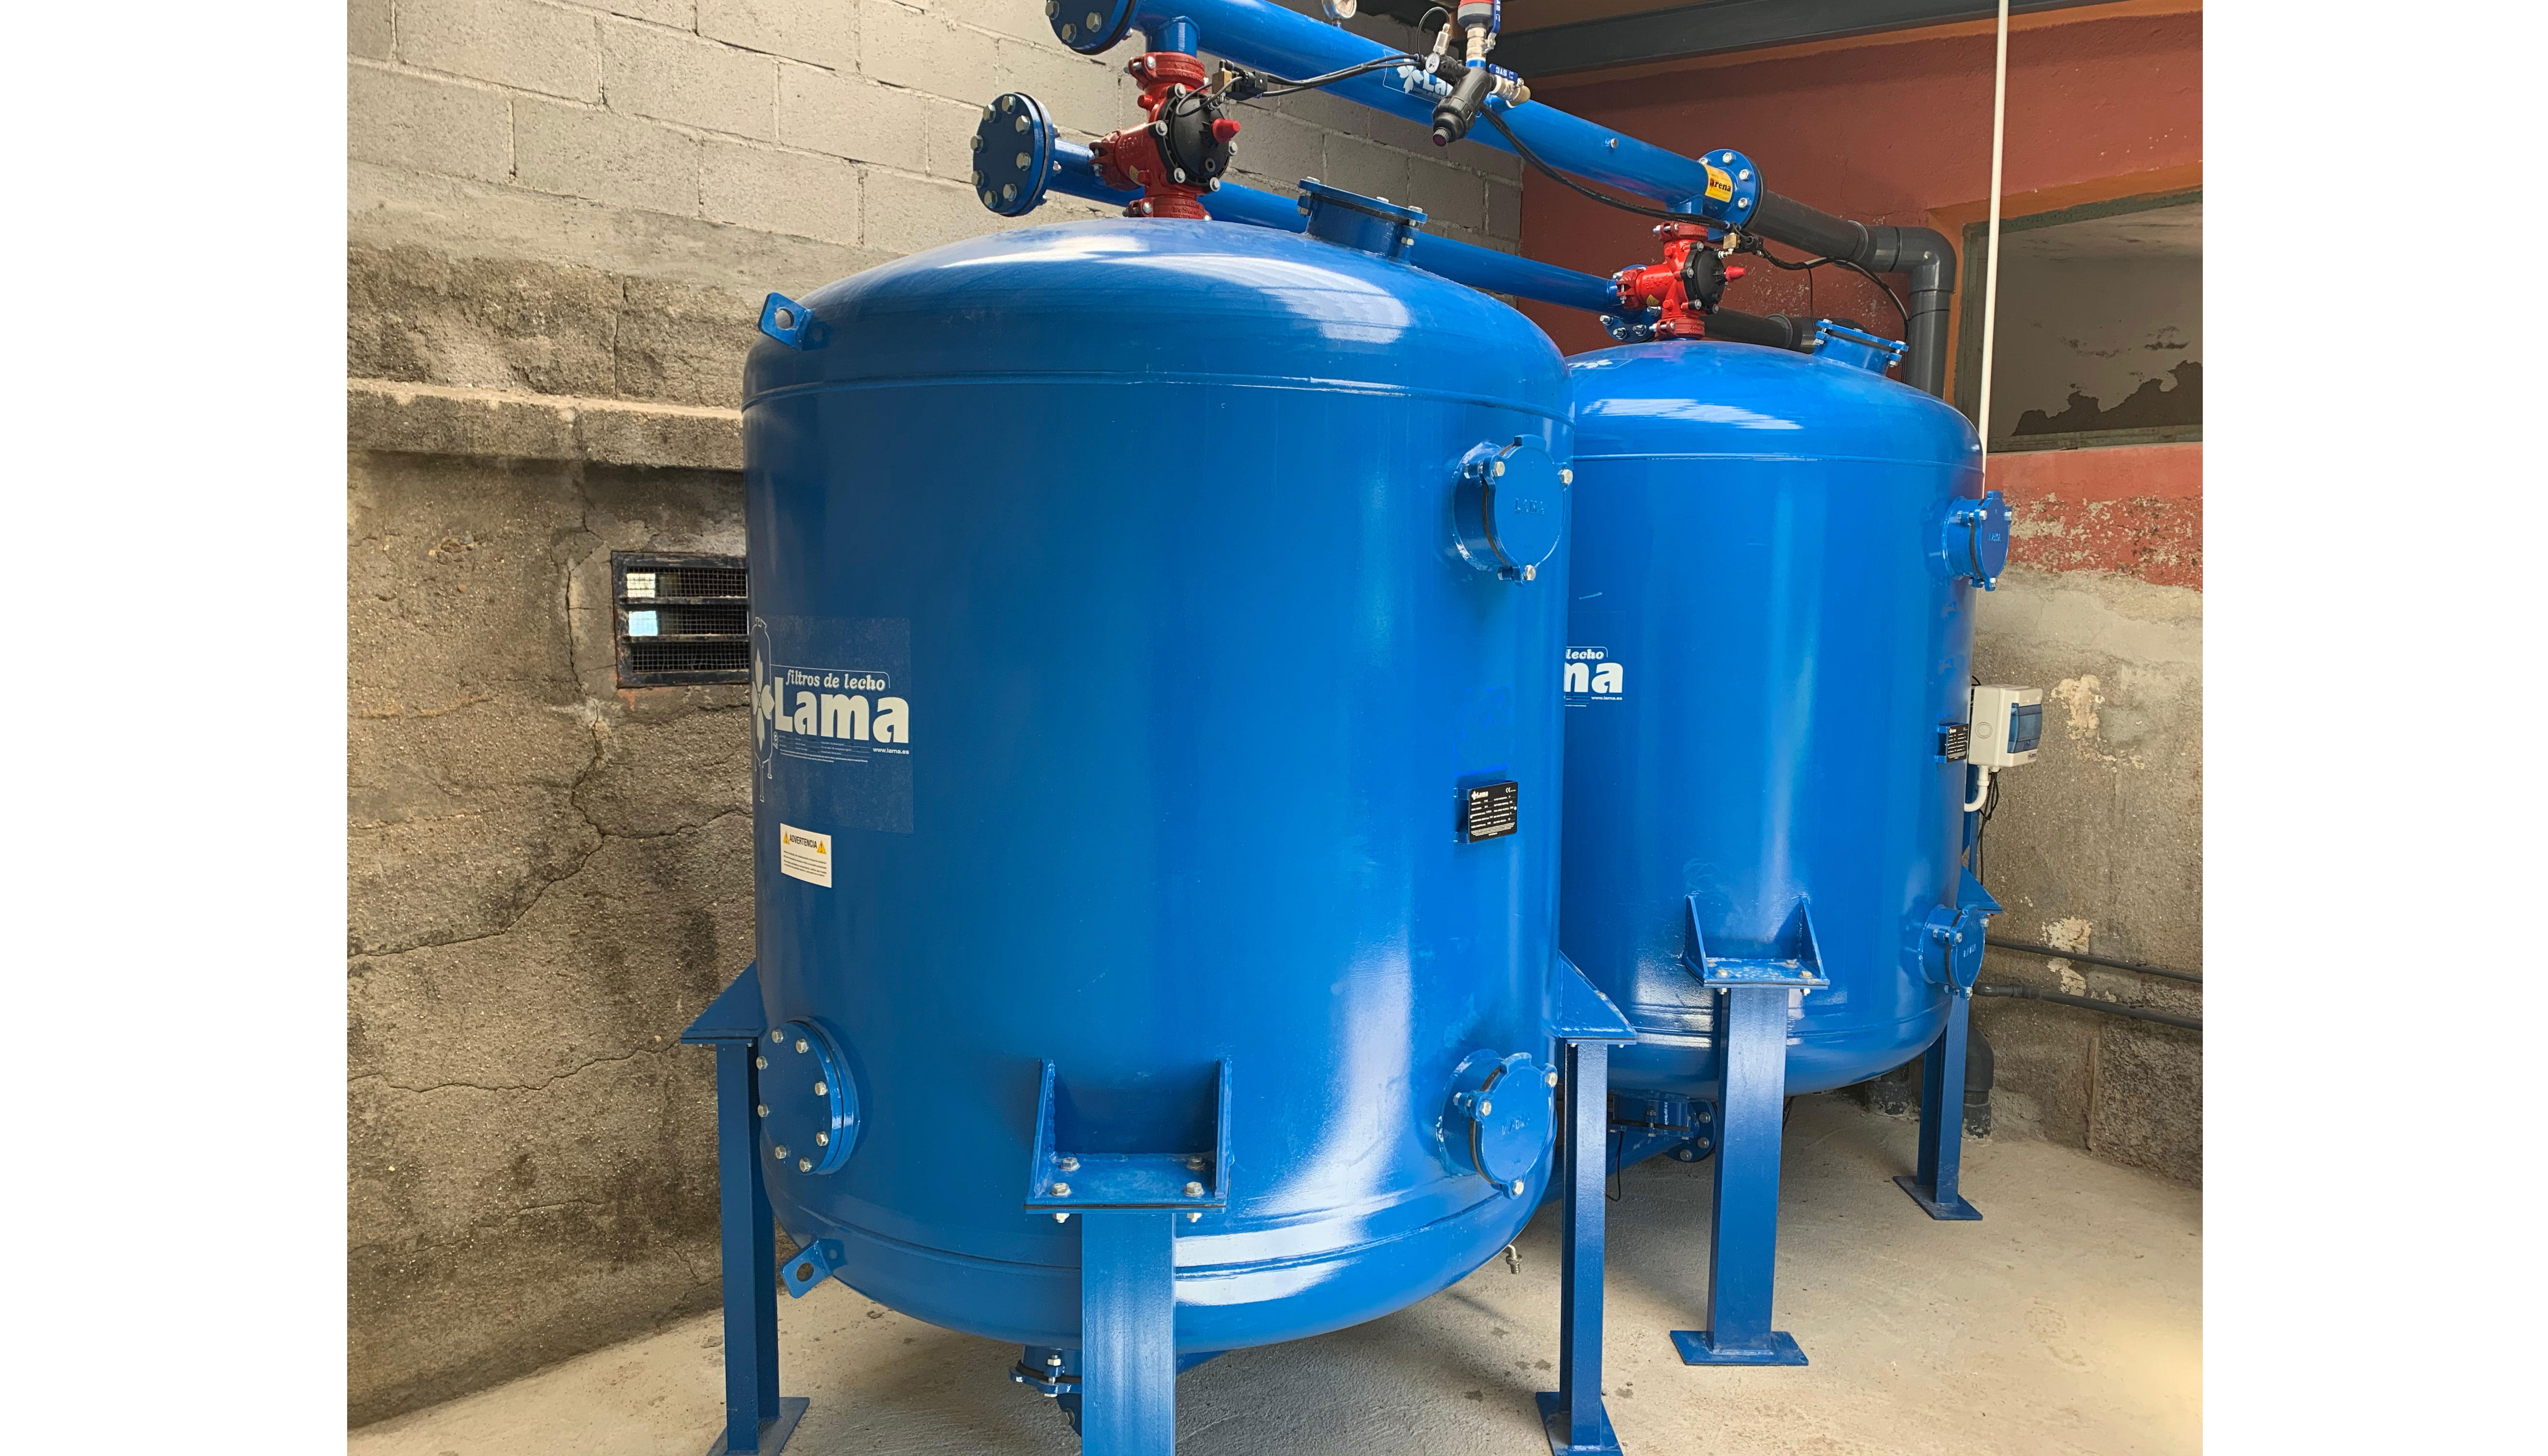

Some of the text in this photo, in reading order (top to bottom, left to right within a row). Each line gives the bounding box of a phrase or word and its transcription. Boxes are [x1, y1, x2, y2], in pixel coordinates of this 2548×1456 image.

[1495, 66, 1507, 76] SYC
[1710, 179, 1731, 192] arena
[1566, 649, 1604, 660] lecho
[785, 669, 886, 691] filtros de lecho
[774, 677, 910, 744] Lama
[872, 747, 910, 755] www.lama.es
[789, 834, 817, 849] ADVERTENCIA
